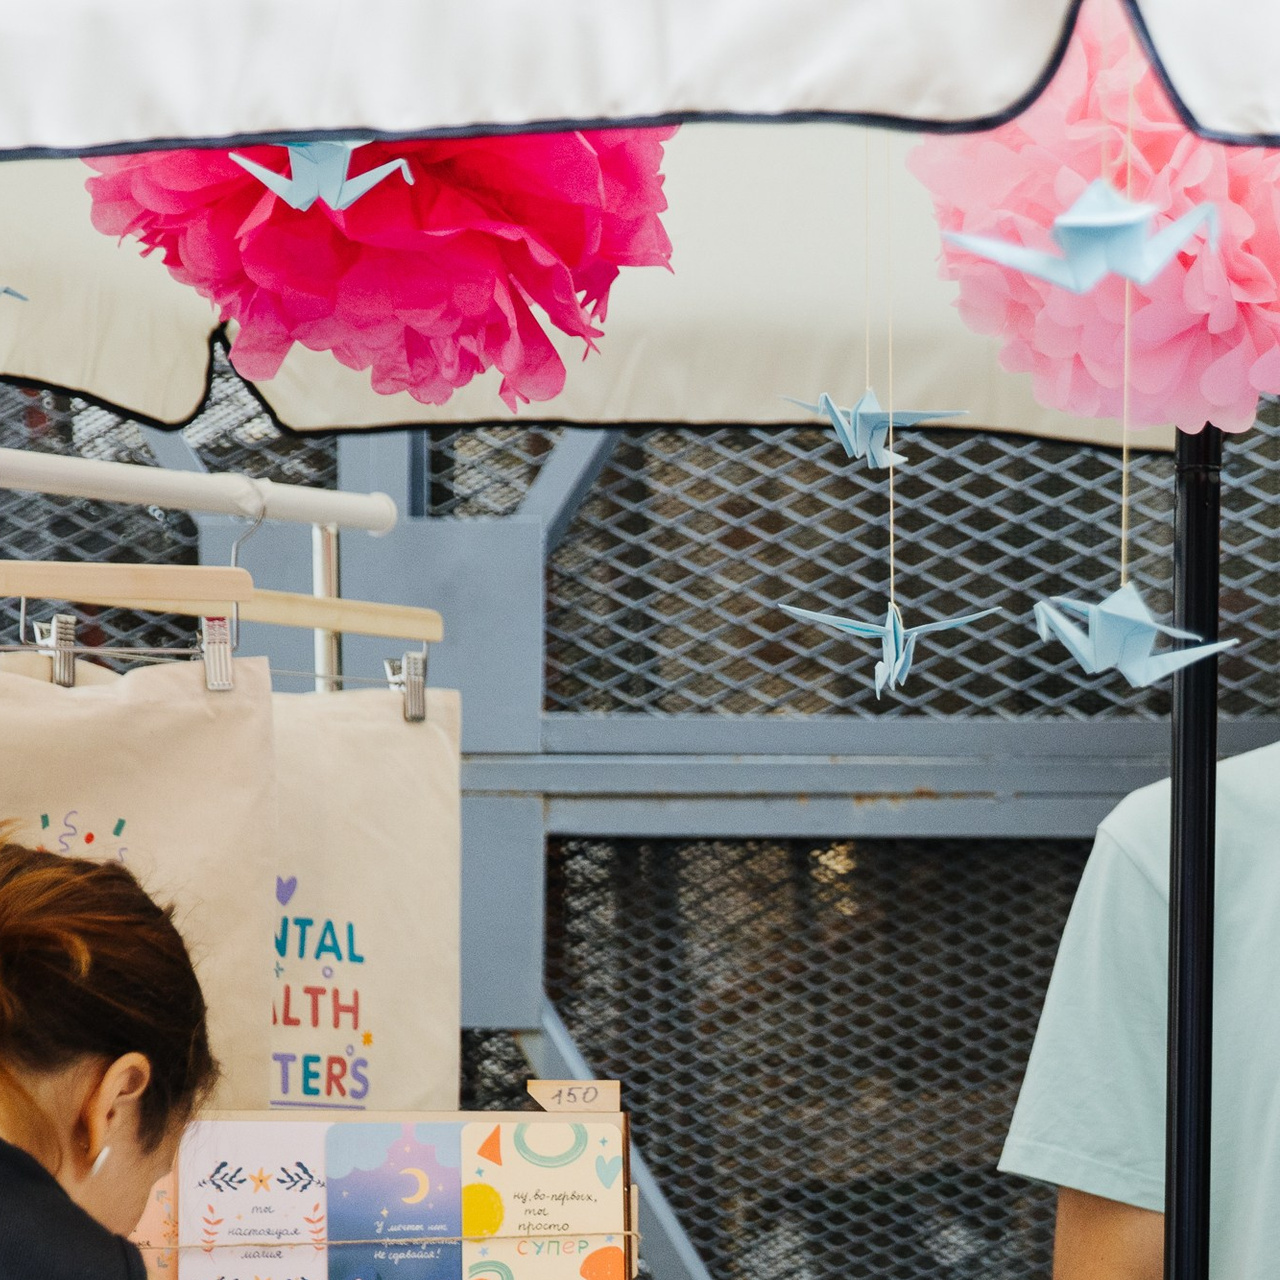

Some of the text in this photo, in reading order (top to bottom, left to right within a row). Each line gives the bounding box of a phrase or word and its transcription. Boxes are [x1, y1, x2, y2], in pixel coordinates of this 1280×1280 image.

[272, 983, 359, 1031] LTH
[271, 1052, 370, 1100] TERS
[551, 1086, 598, 1105] 150
[251, 1205, 275, 1214] ты
[524, 1207, 549, 1217] ты
[227, 1227, 301, 1240] настоящая
[517, 1222, 570, 1236] просто
[240, 1250, 284, 1260] магия
[388, 1247, 441, 1265] сдавайся!
